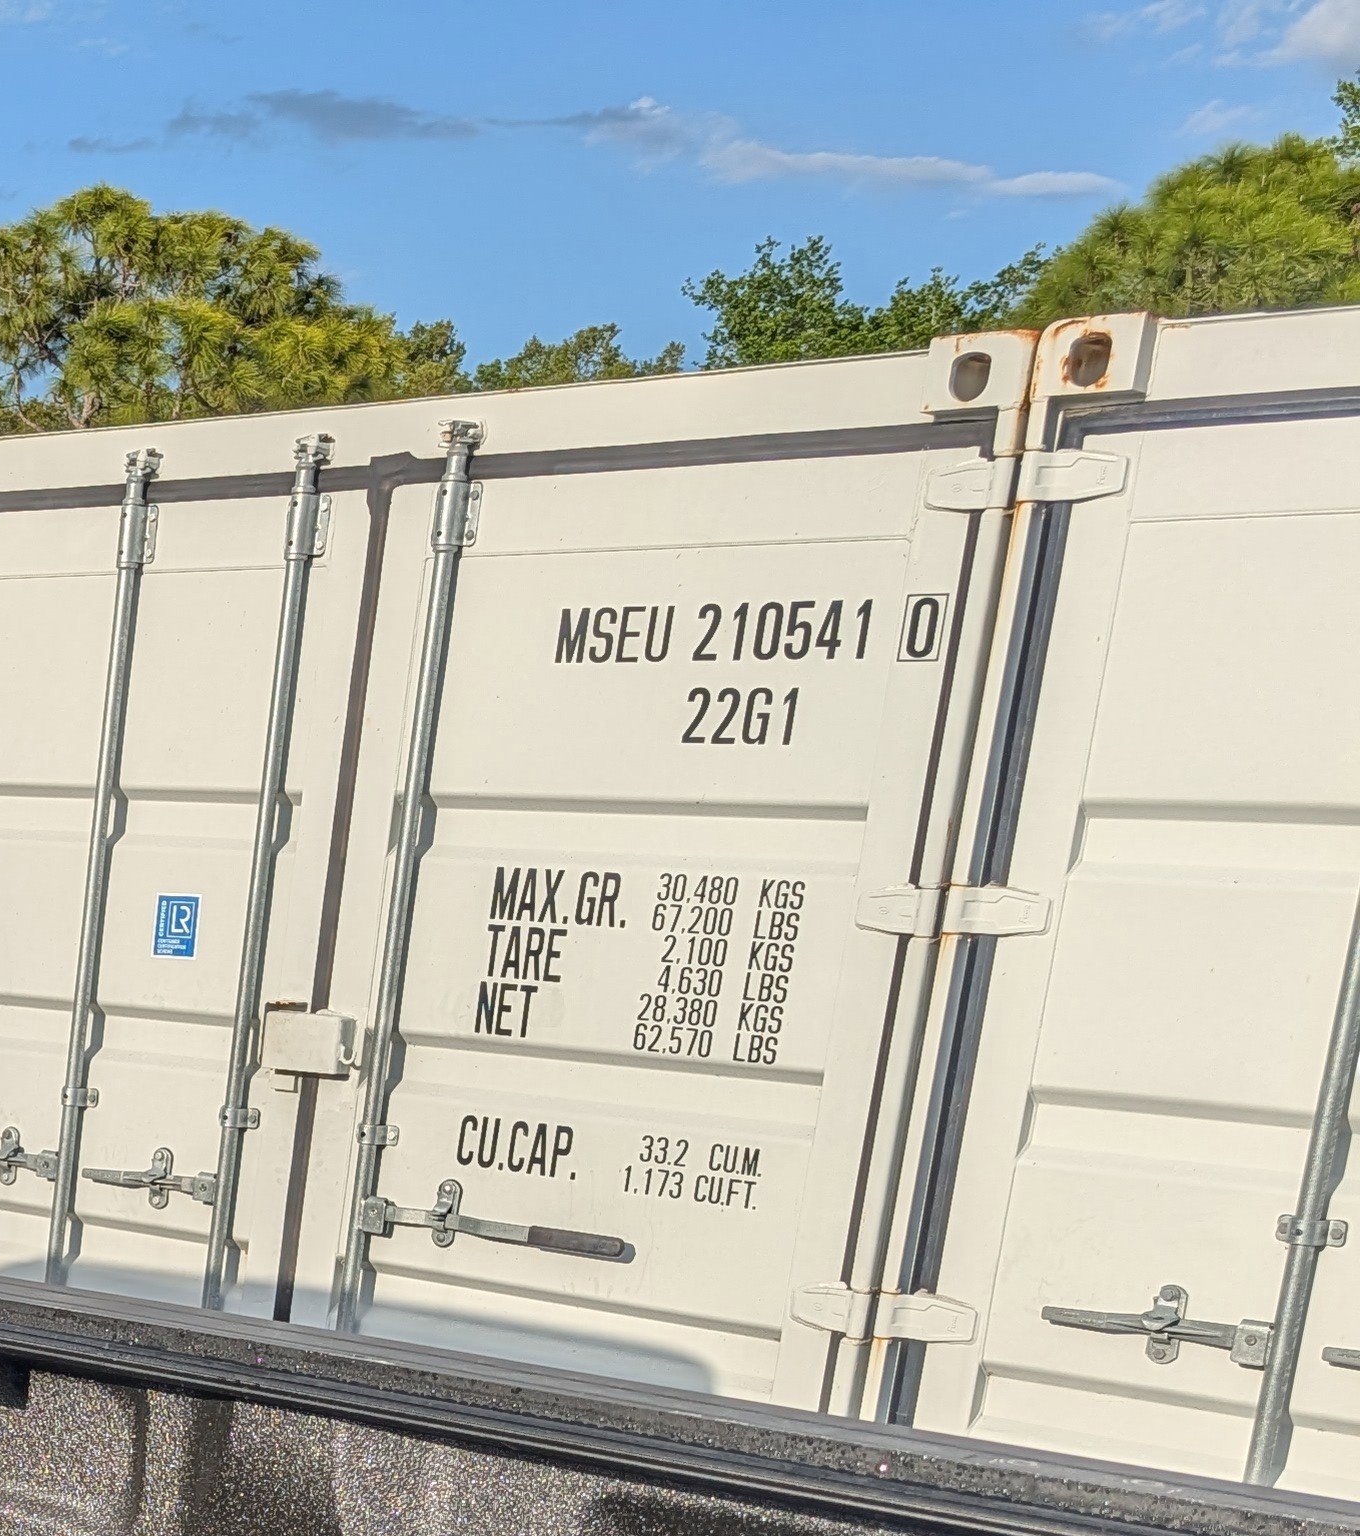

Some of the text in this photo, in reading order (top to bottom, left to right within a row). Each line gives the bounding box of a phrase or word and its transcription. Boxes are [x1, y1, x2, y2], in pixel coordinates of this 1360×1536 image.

[555, 597, 940, 663] MSEU 210541 0
[681, 687, 799, 745] 22G1
[758, 879, 805, 910] KGS
[171, 904, 191, 934] LR
[753, 910, 800, 941] LBS
[487, 924, 568, 983] TARE
[748, 941, 795, 973] KGS
[743, 972, 789, 1003] LBS
[474, 981, 538, 1038] NET
[737, 1003, 784, 1034] KGS
[732, 1033, 779, 1065] LBS
[639, 1135, 762, 1178] 33.2 CU.M.
[693, 1175, 758, 1210] CU.FT.
